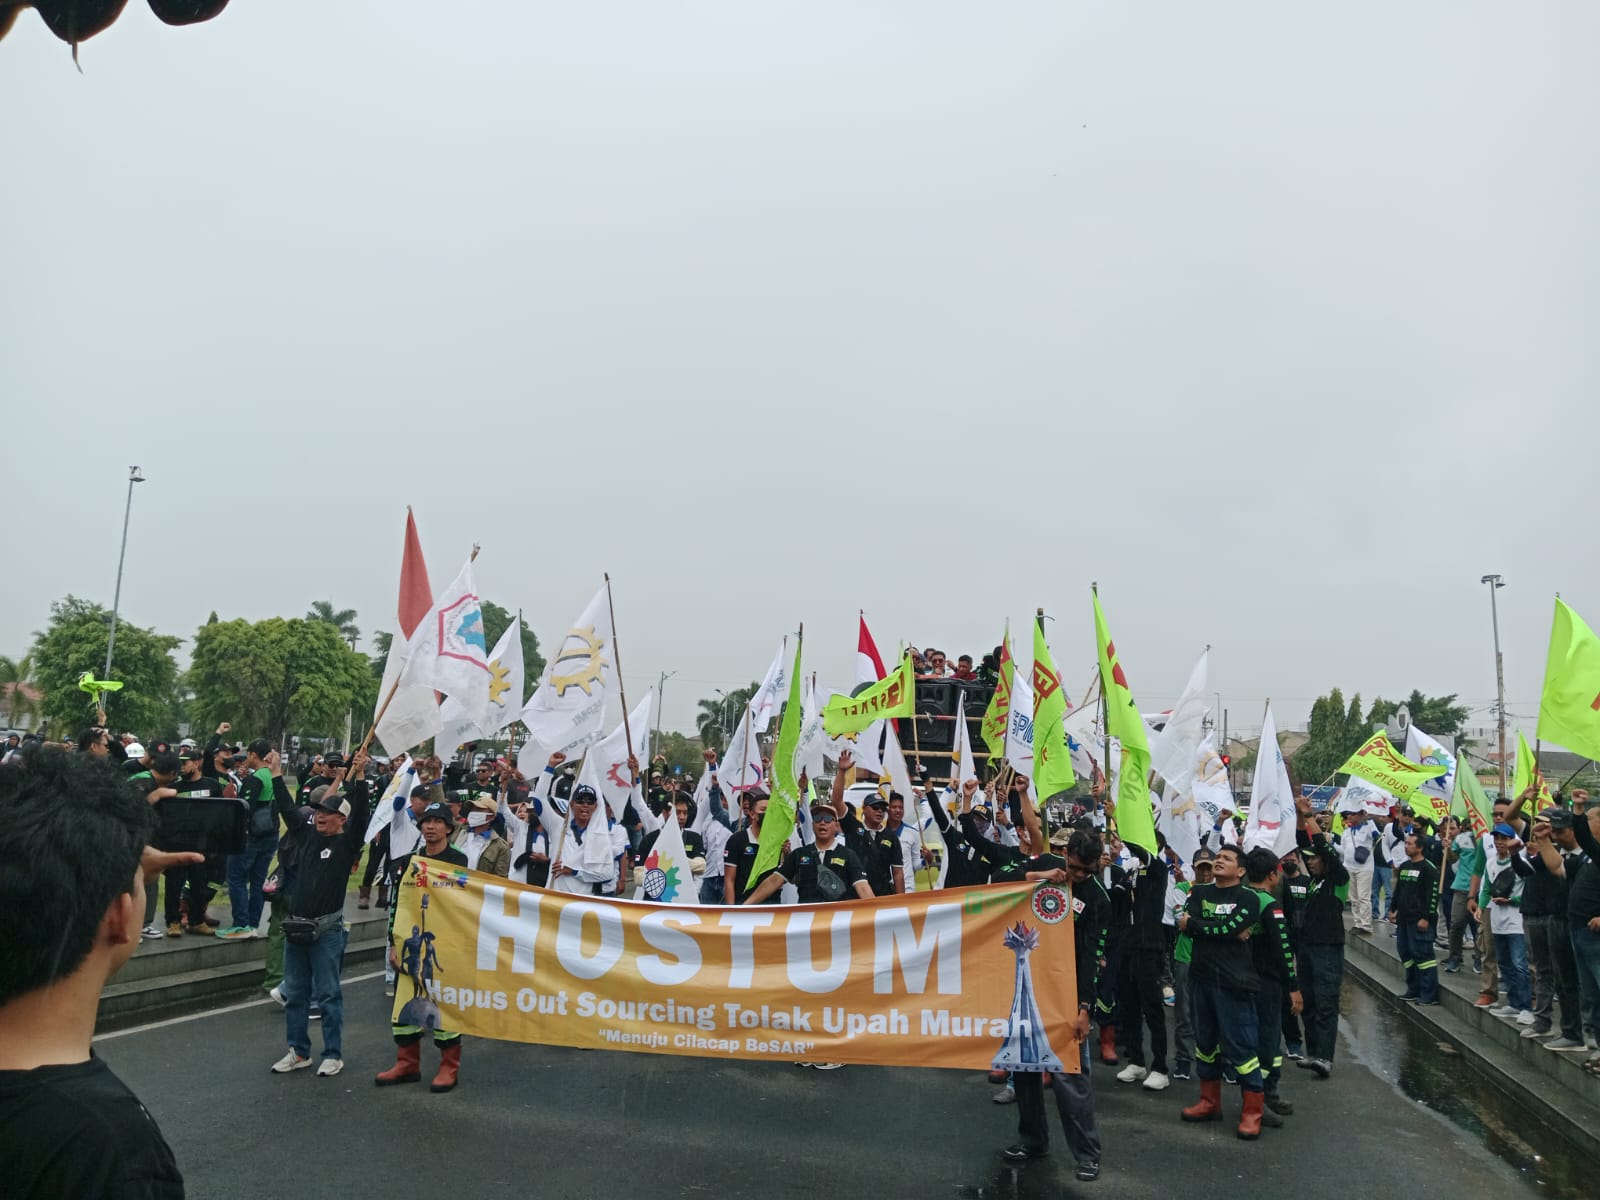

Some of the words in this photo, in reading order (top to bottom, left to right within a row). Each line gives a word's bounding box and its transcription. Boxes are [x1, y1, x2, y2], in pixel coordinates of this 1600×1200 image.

[476, 884, 963, 995] HOSTUM
[424, 978, 508, 1012] Hapus
[516, 988, 568, 1016] Out
[576, 992, 717, 1032] Sourcing
[723, 1003, 812, 1032] Tolak
[822, 1007, 909, 1038] Upah
[920, 1008, 1033, 1039] Murah
[673, 1034, 740, 1053] Cilacap
